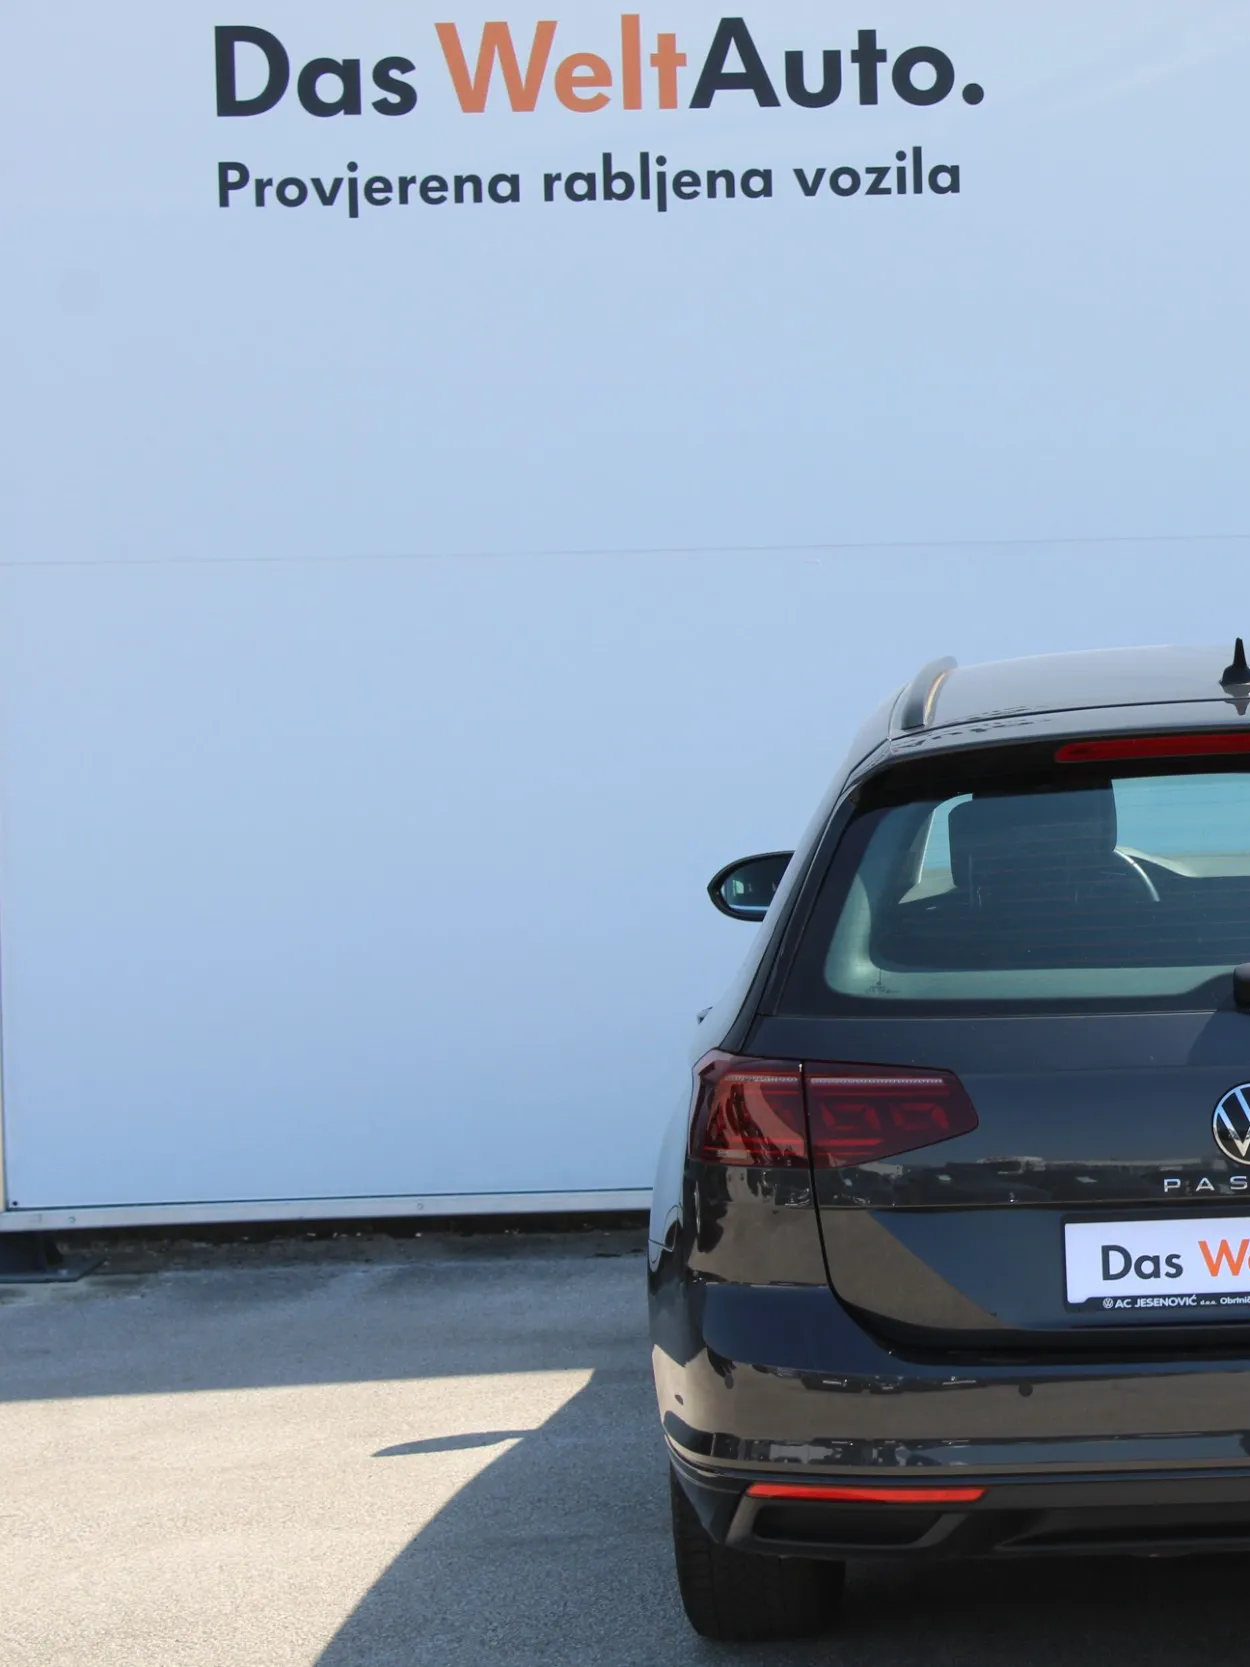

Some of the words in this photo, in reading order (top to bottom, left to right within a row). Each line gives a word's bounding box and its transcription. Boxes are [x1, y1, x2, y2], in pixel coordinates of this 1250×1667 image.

[214, 25, 418, 118] Das
[434, 14, 985, 114] WeltAuto.
[217, 161, 521, 219] Provjerena
[543, 152, 774, 212] rabljena
[792, 146, 961, 198] vozila
[1101, 1243, 1184, 1281] Das
[1115, 1299, 1132, 1308] AC
[1134, 1294, 1197, 1308] JESENOVIĆ
